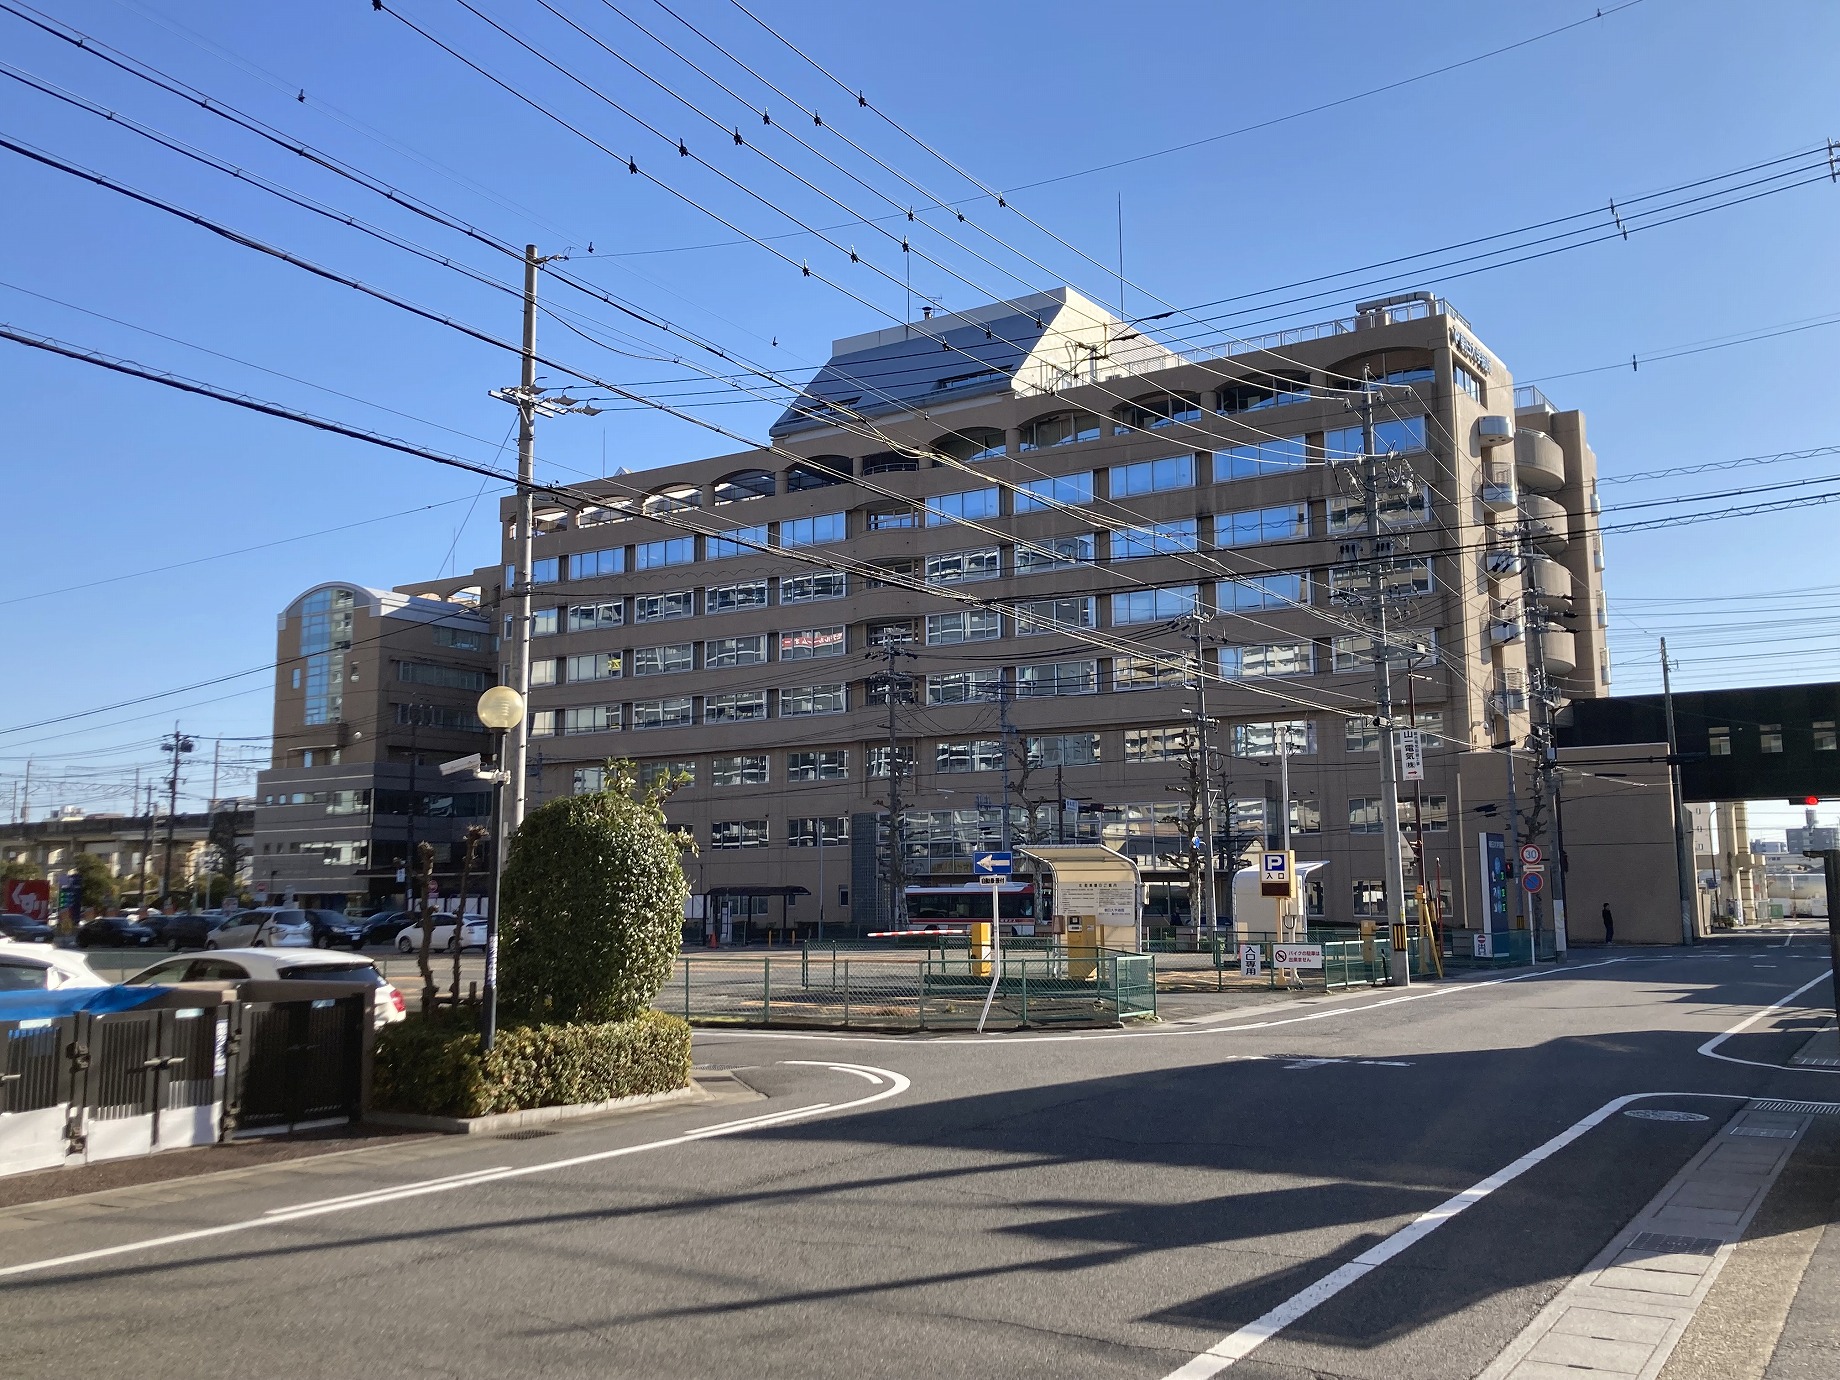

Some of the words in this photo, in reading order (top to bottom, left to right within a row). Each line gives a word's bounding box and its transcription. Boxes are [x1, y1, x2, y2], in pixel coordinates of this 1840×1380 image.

[1525, 850, 1537, 859] 30
[1267, 855, 1283, 870] P
[1245, 946, 1256, 975] 入口専用
